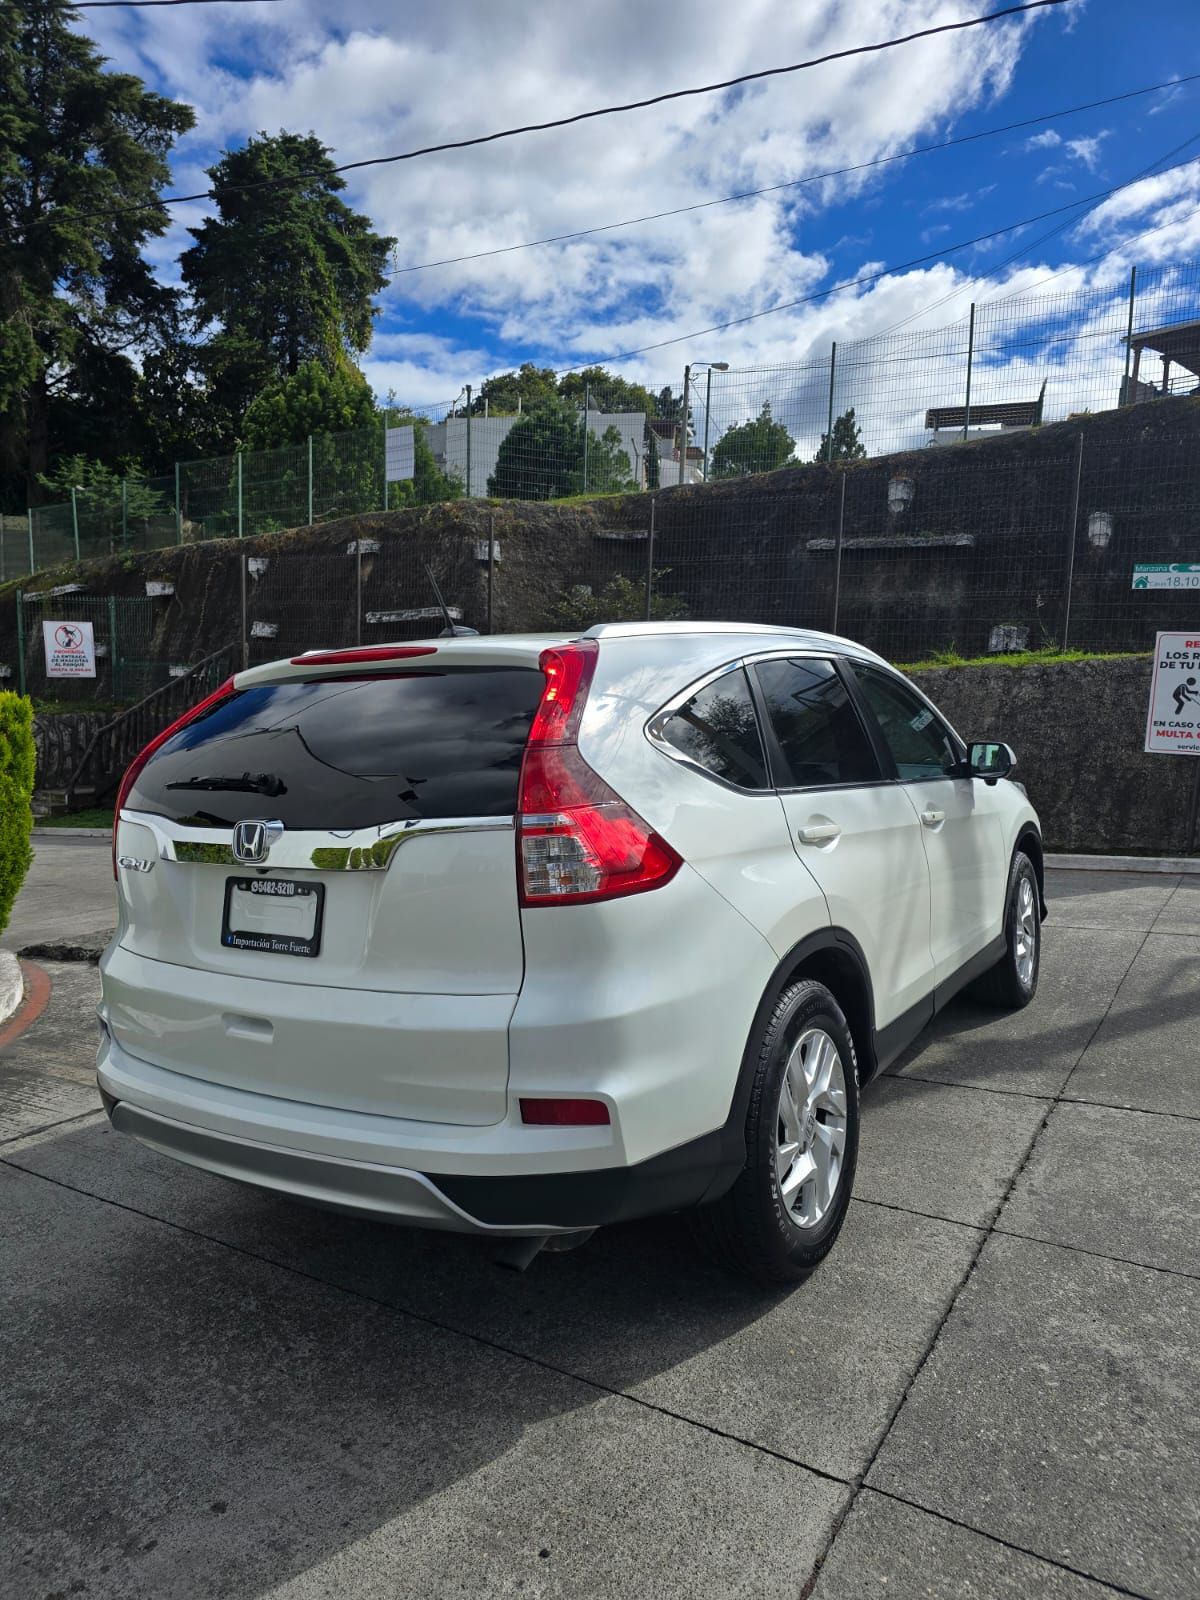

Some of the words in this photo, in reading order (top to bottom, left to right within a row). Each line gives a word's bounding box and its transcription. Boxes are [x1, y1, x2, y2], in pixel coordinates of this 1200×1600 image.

[1166, 651, 1189, 660] LOS
[1160, 661, 1176, 669] DE
[1179, 661, 1195, 669] TU
[1156, 730, 1193, 739] MULTA
[258, 881, 294, 895] 5482-5210
[233, 935, 270, 949] Importación
[271, 939, 288, 951] Torre
[289, 941, 311, 954] Fuerte
